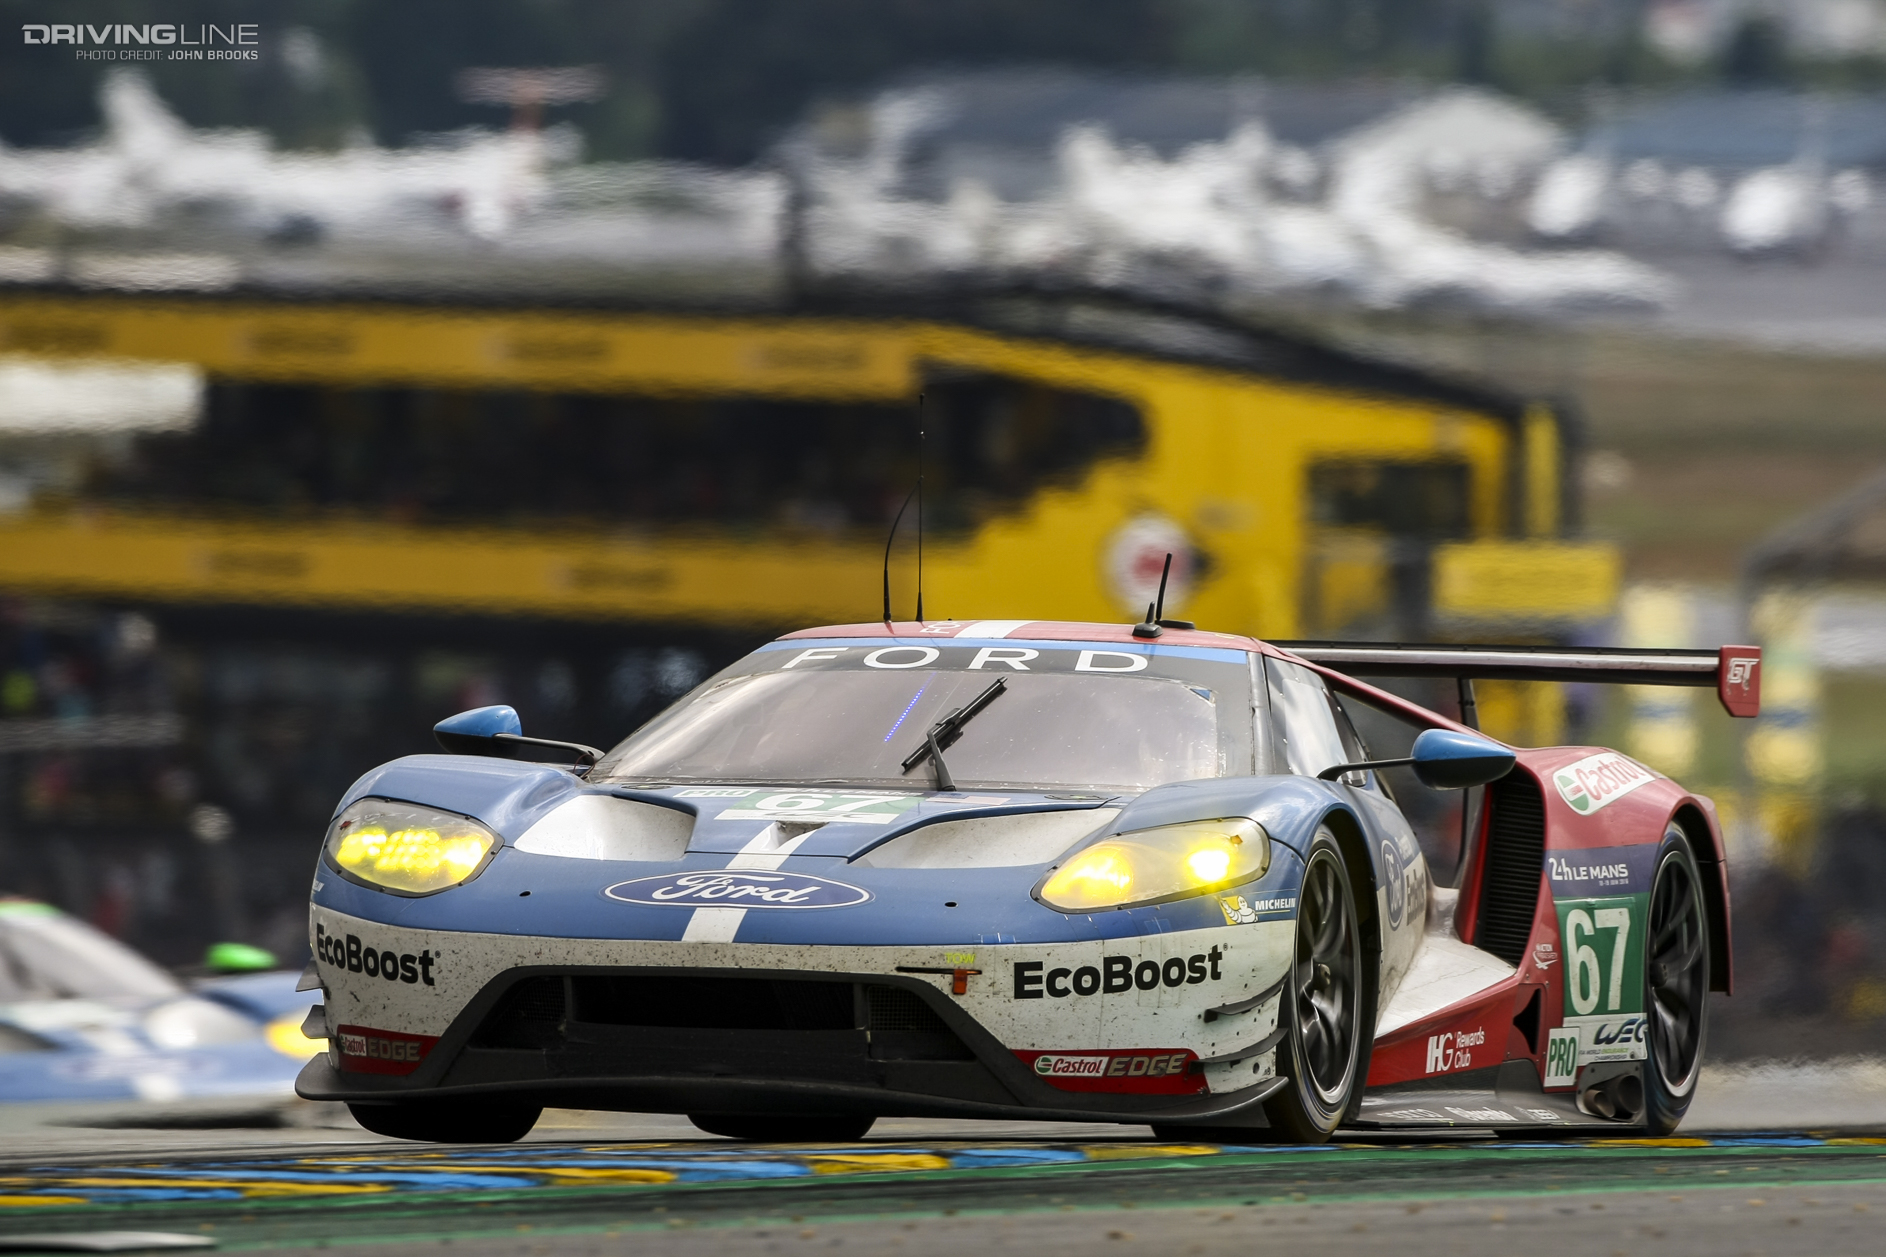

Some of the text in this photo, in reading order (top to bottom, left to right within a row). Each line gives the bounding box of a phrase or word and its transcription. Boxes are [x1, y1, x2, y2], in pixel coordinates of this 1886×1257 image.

[781, 646, 1149, 673] FORD
[1727, 657, 1760, 685] GT
[1575, 756, 1647, 801] Castrol
[755, 793, 908, 812] 67
[1548, 858, 1629, 881] 24h LE MANS
[651, 873, 823, 903] Ford
[1255, 897, 1297, 911] MICHELIN
[316, 922, 435, 987] EcoBoost
[945, 952, 977, 965] TOW
[1566, 907, 1631, 1015] 67
[1013, 944, 1223, 1000] EcoBoost
[368, 1037, 423, 1062] EDGE
[1455, 1025, 1485, 1049] Rewards
[1051, 1053, 1189, 1077] Castrol EDGE
[1425, 1032, 1454, 1074] IHG
[1454, 1047, 1472, 1069] Club
[1546, 1036, 1578, 1078] PRO
